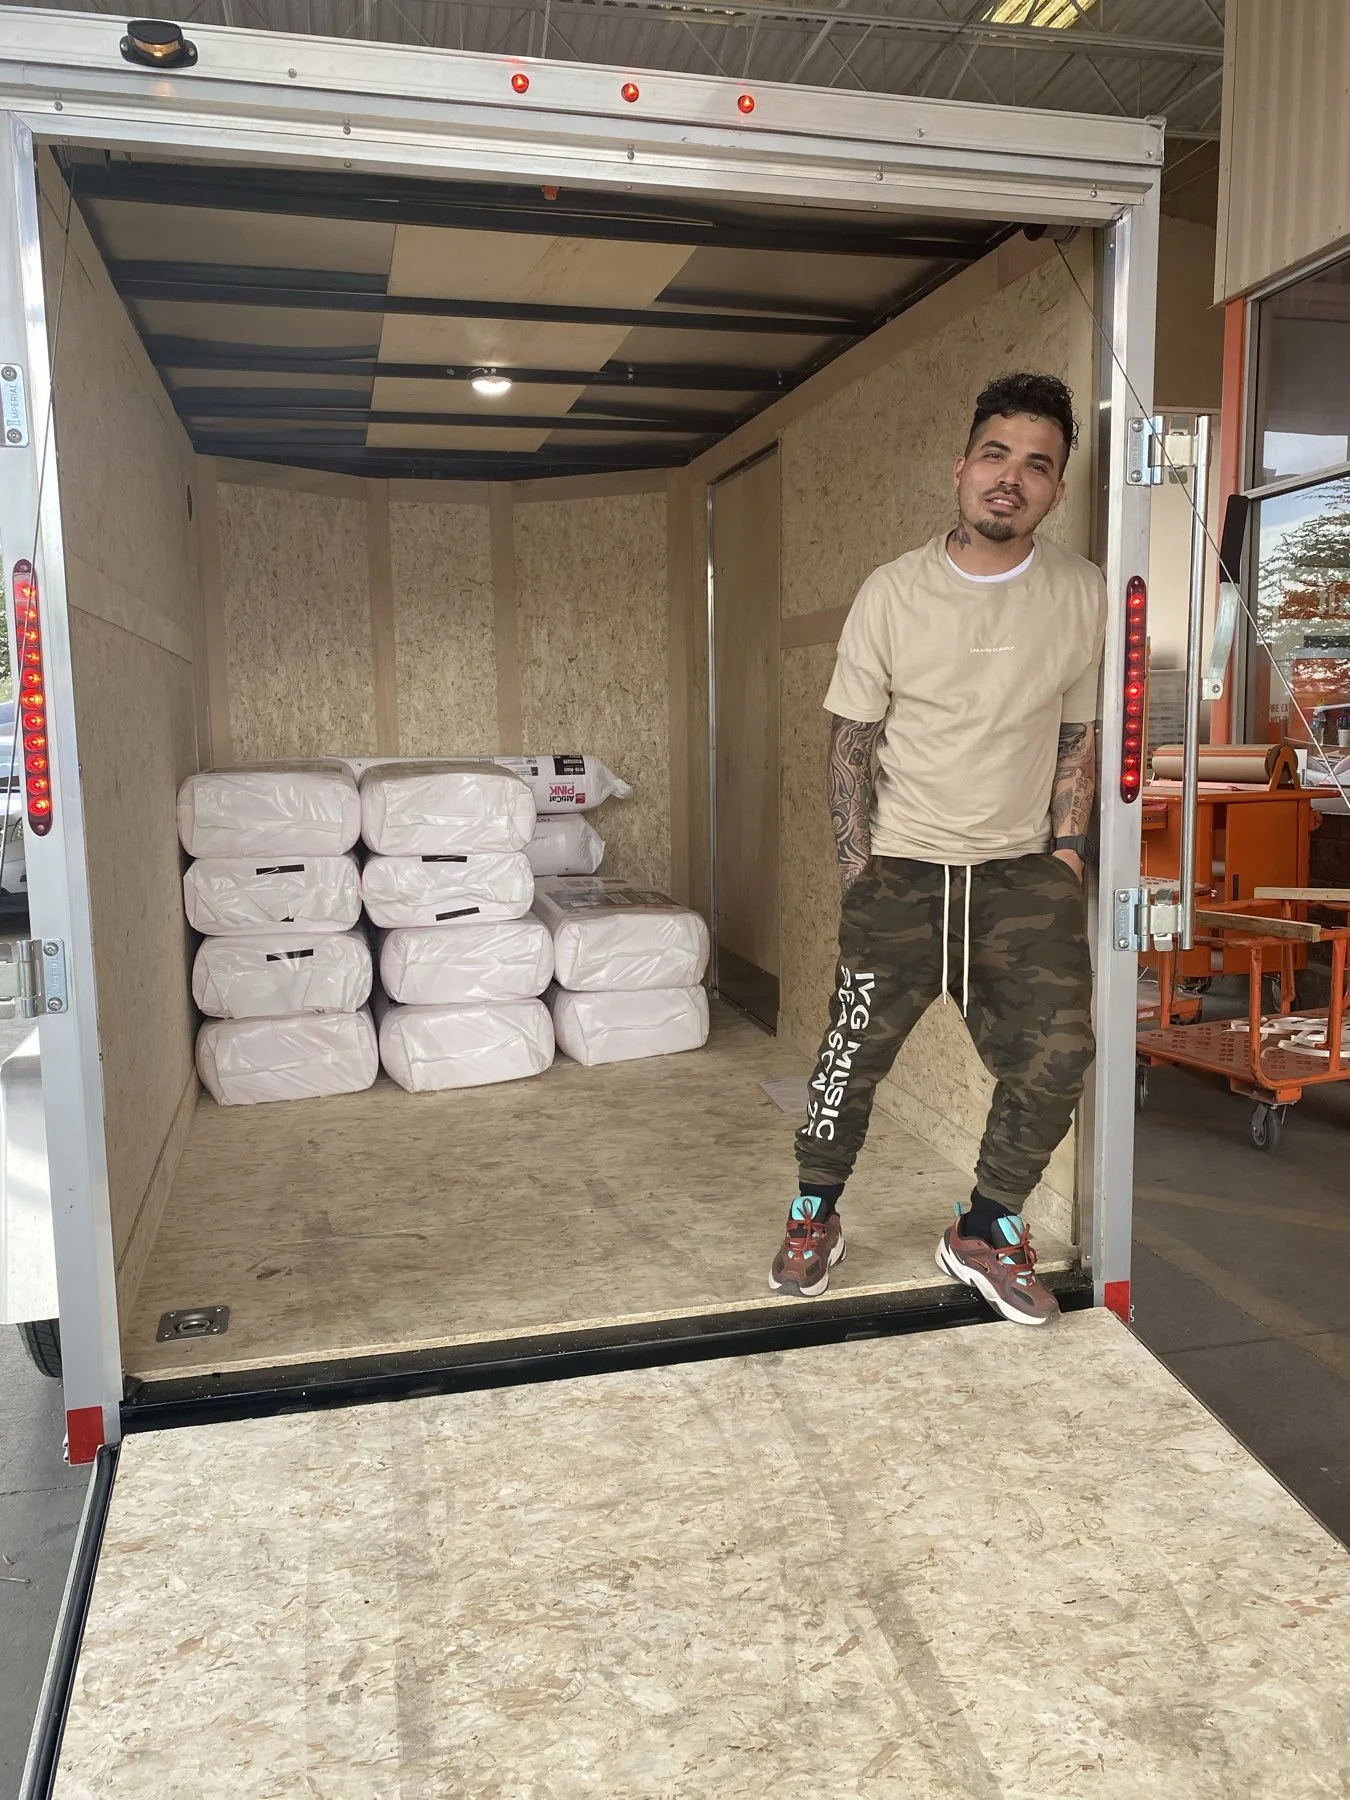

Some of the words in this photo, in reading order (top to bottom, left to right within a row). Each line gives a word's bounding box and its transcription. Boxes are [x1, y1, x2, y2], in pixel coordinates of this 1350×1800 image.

[549, 785, 575, 795] PINK
[549, 795, 575, 803] AttiCat
[811, 964, 855, 1092] SEASON
[816, 1040, 862, 1141] MUSIC
